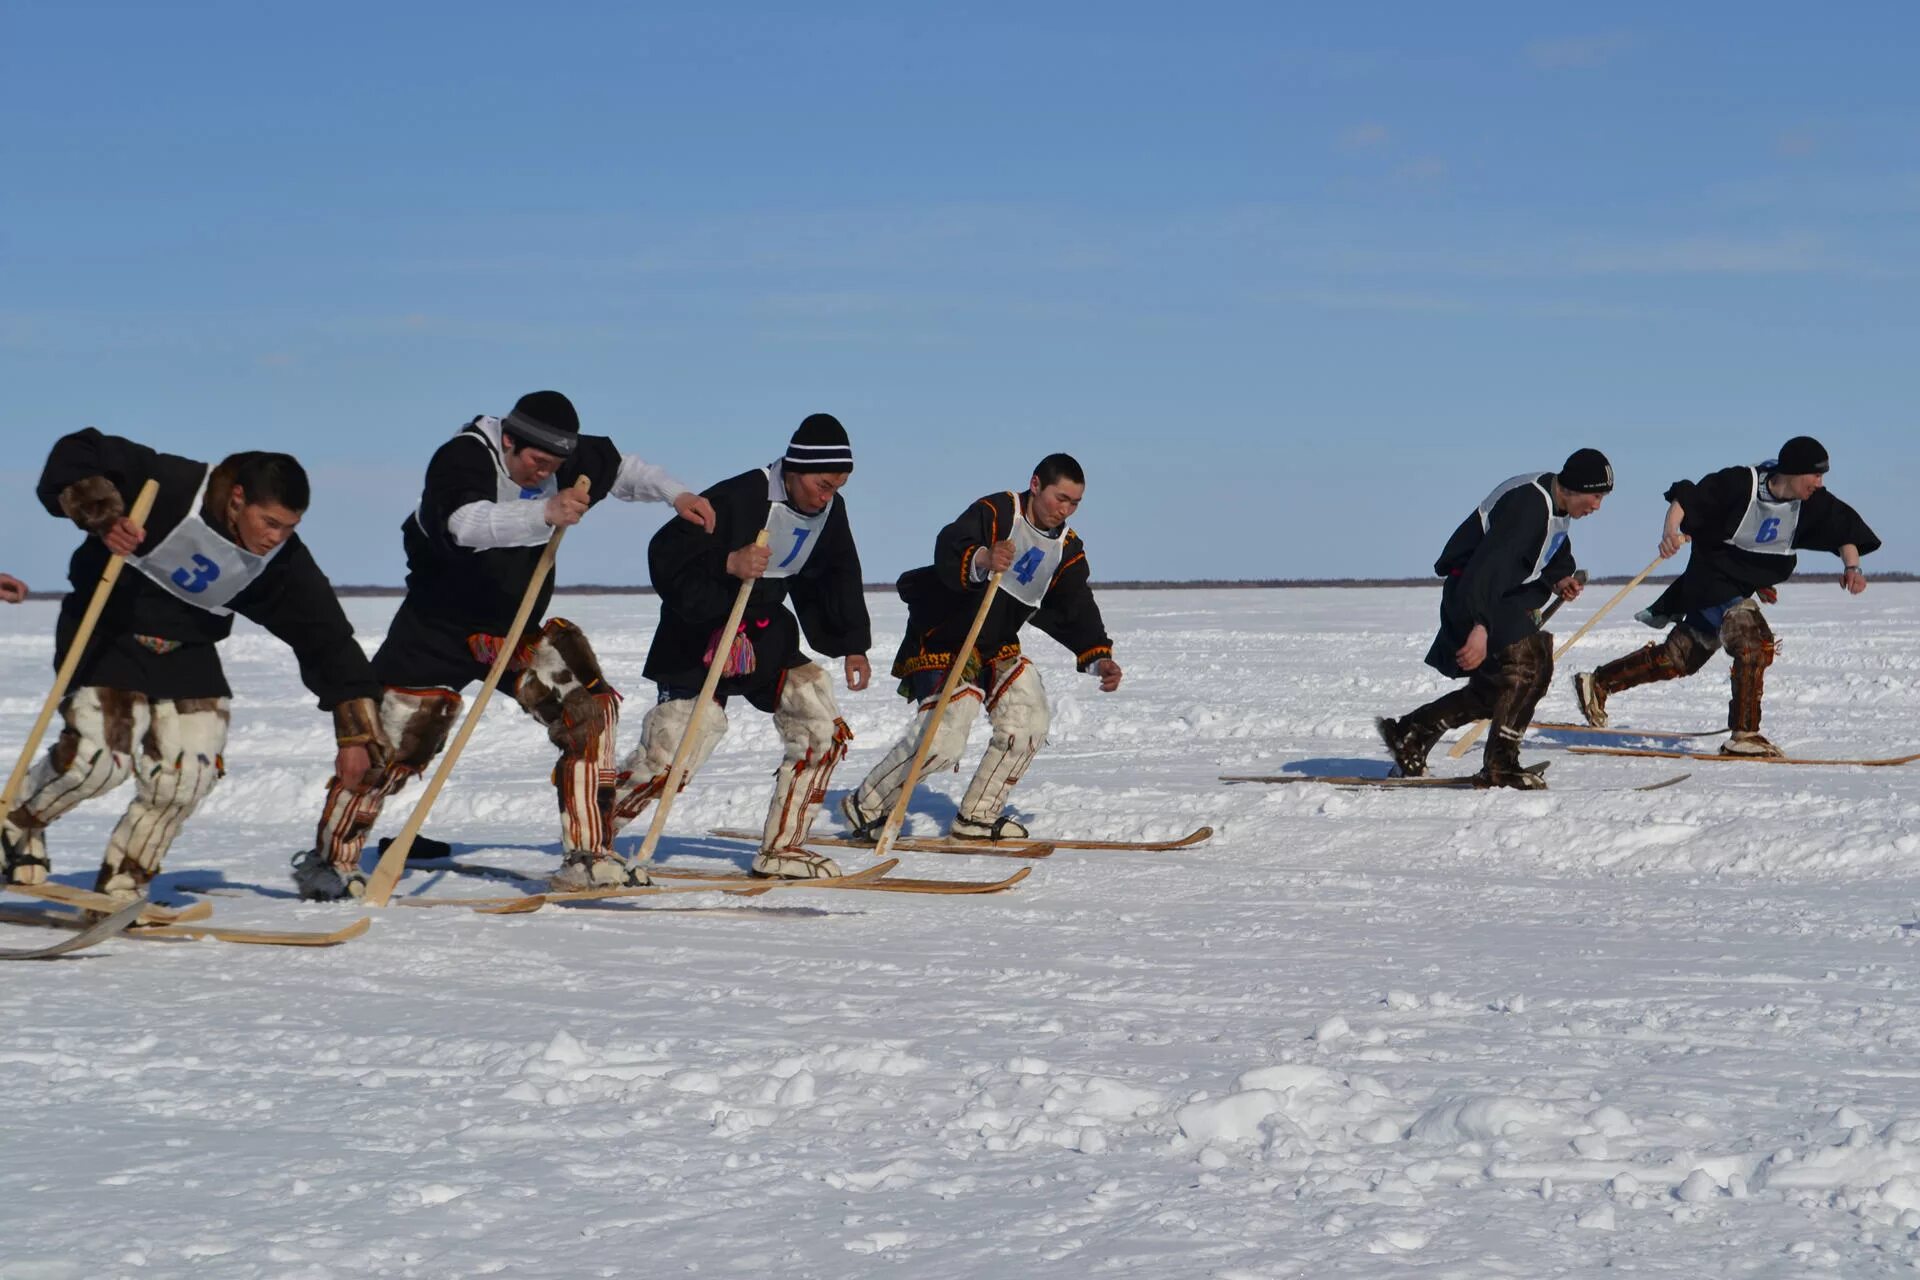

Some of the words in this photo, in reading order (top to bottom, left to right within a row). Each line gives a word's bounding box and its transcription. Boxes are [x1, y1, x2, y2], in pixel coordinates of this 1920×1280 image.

[1755, 517, 1780, 544] 6
[171, 553, 220, 593] 3
[1013, 546, 1046, 585] 4
